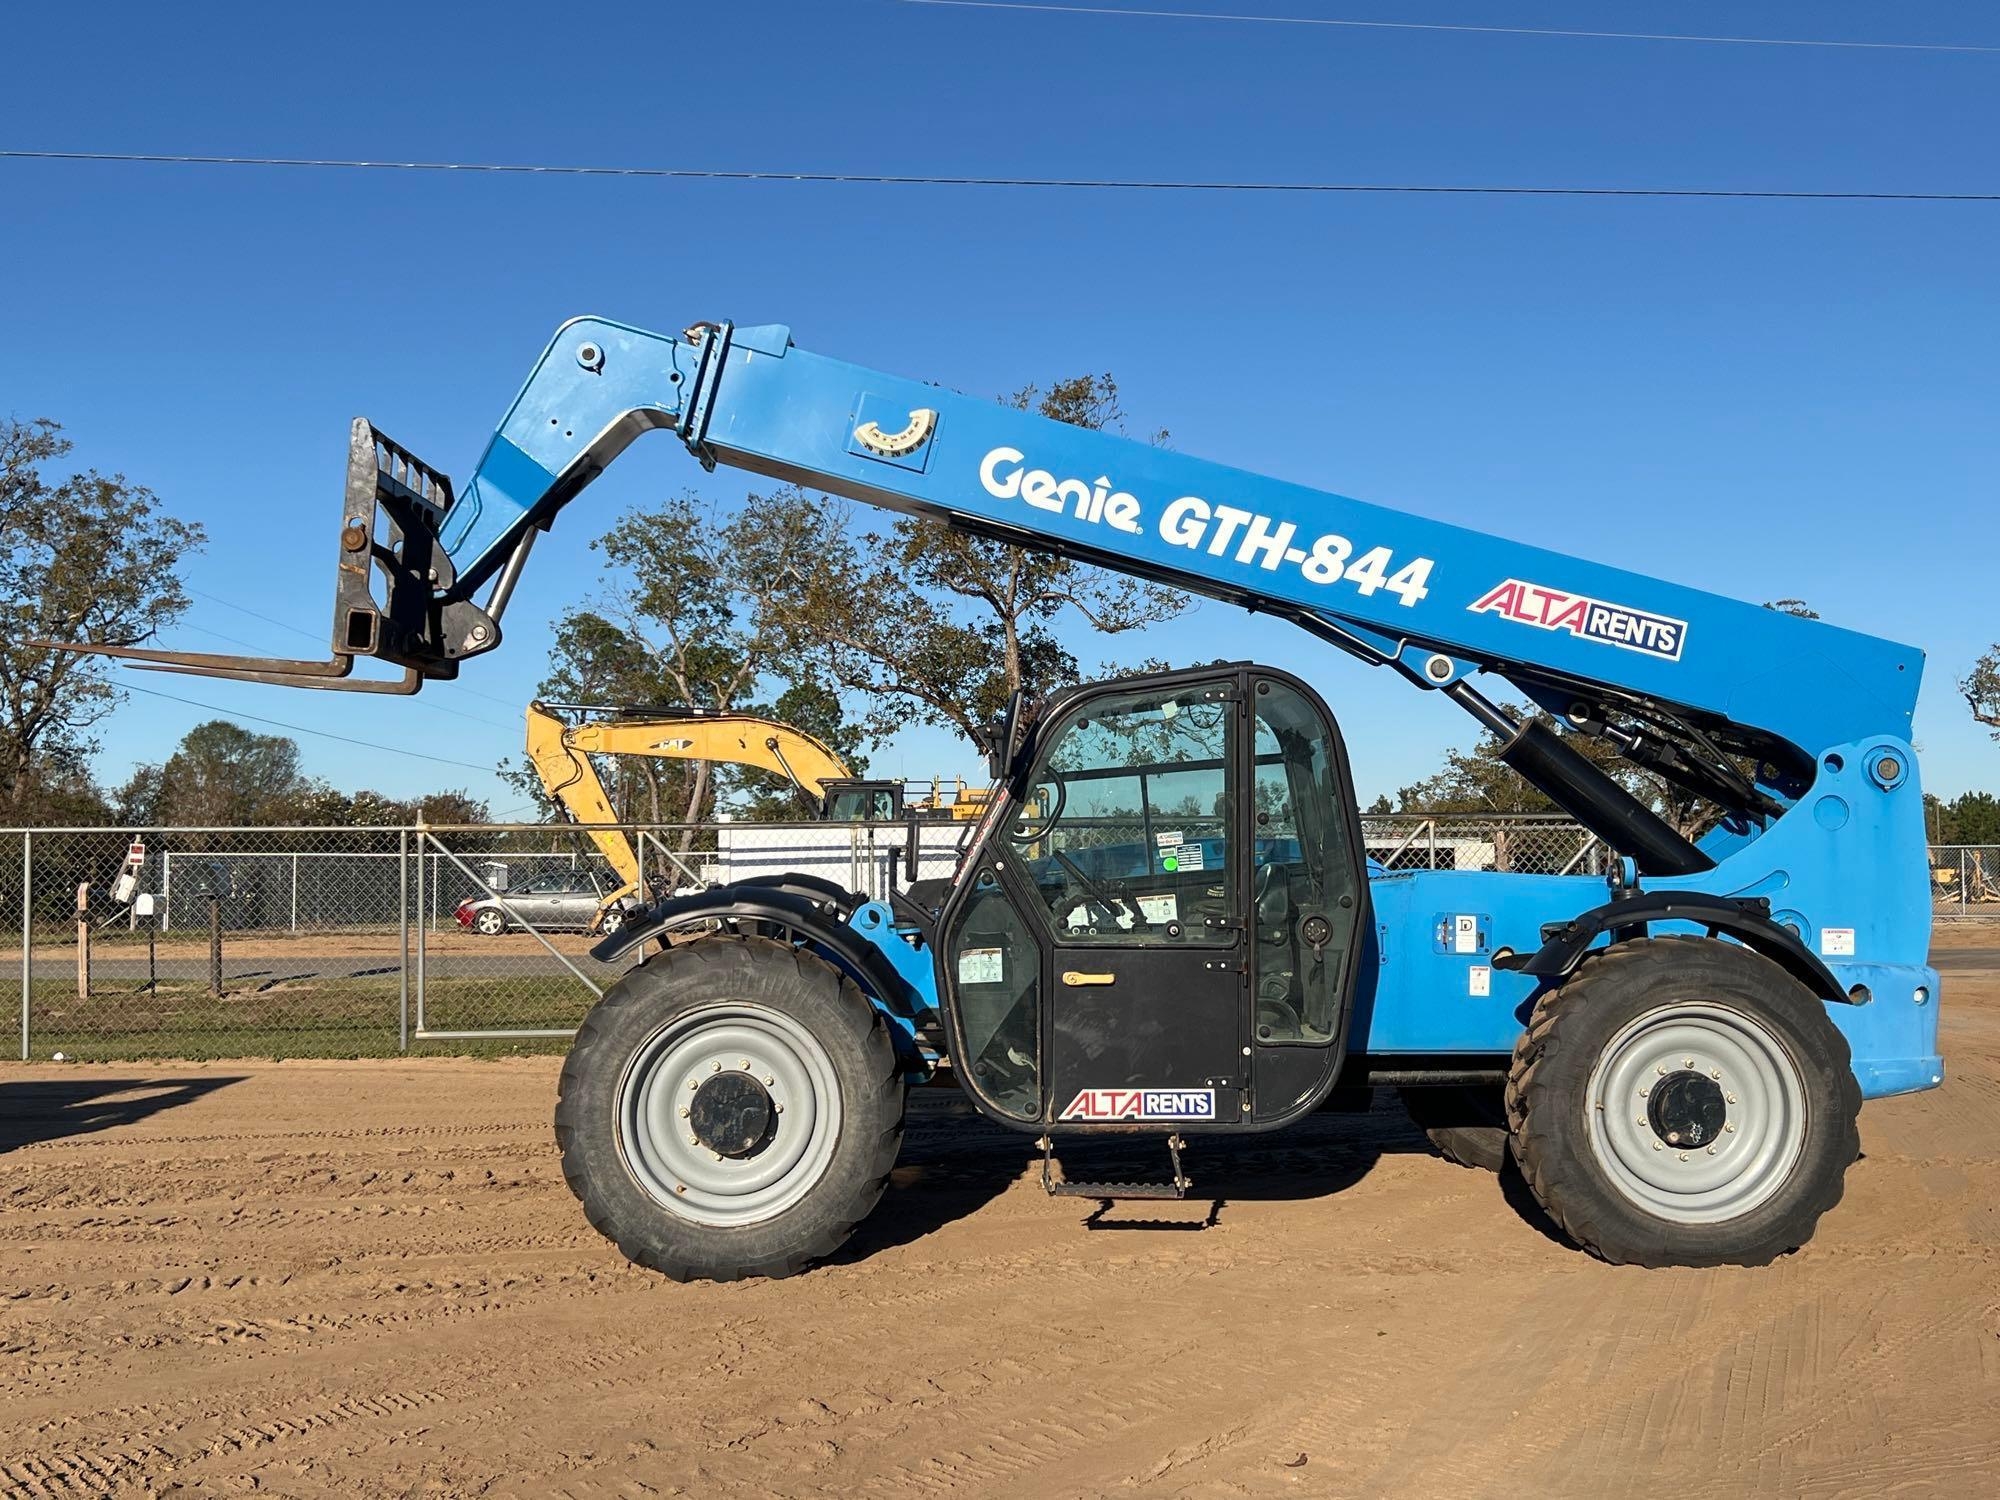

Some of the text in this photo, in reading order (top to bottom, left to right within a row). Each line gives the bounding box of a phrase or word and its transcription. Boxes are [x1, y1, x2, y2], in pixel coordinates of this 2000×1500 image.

[980, 446, 1140, 534] Genie
[1158, 496, 1435, 608] GTH-844
[1475, 582, 1676, 651] ALTA RENTS
[659, 738, 683, 751] CAT
[1065, 1092, 1209, 1116] ALTA RENTS
